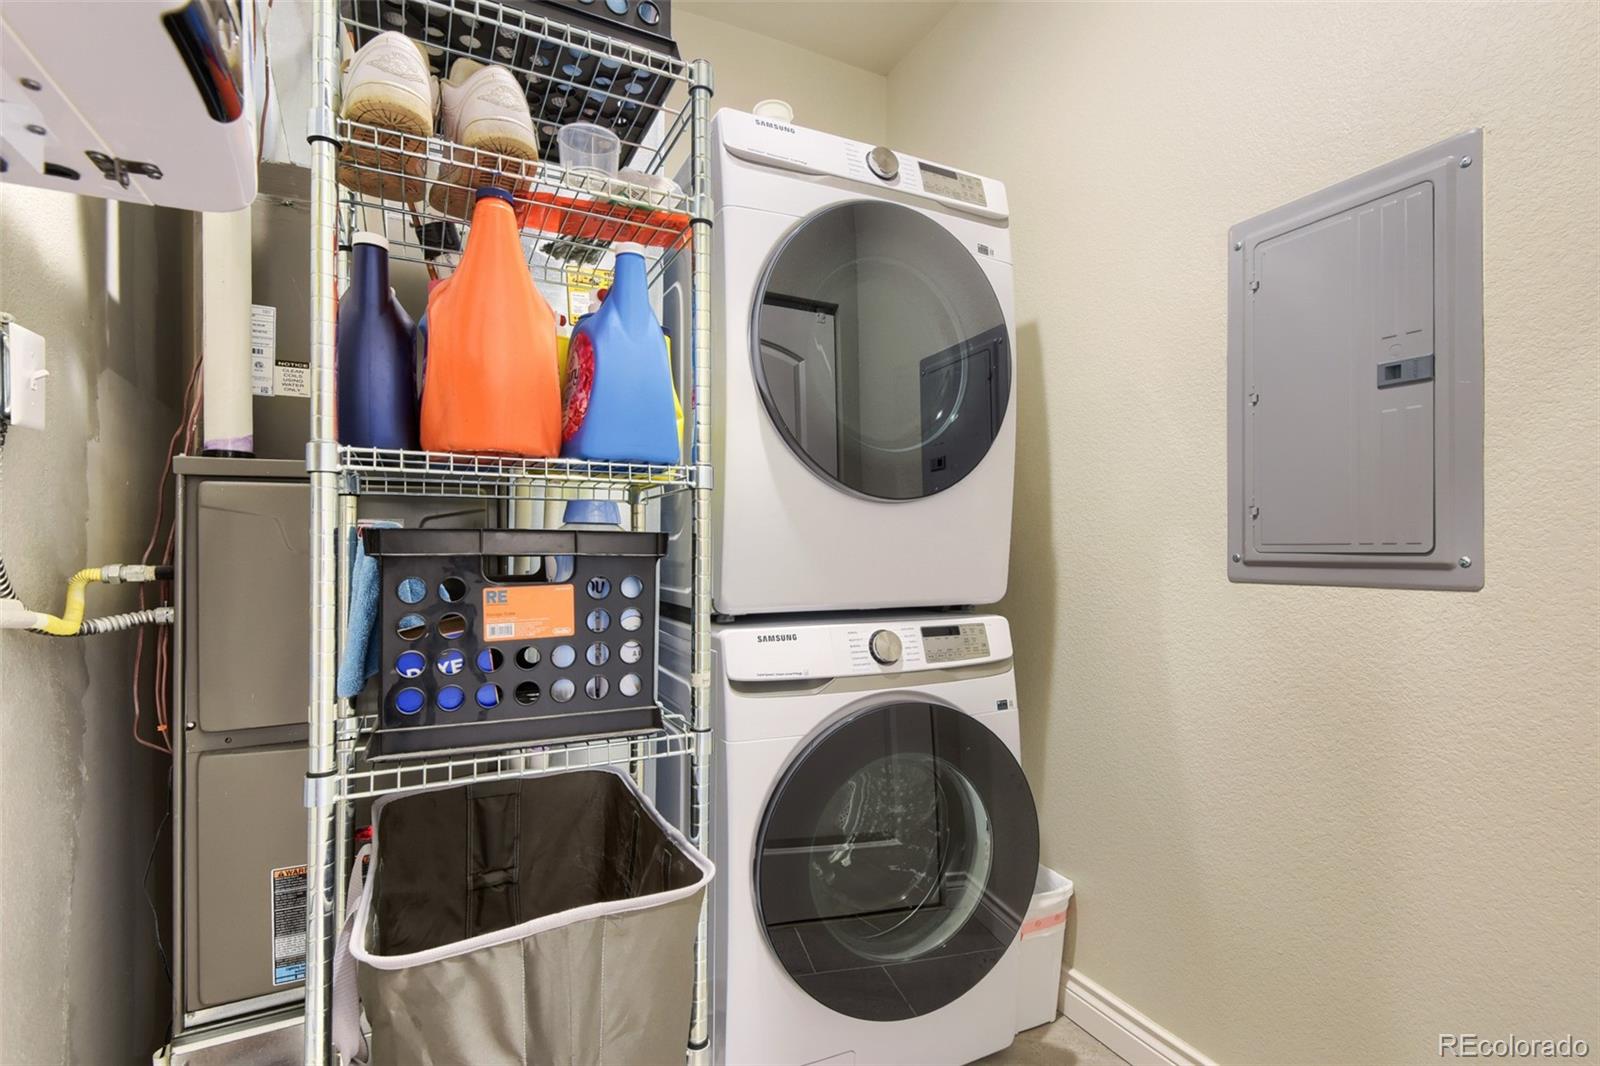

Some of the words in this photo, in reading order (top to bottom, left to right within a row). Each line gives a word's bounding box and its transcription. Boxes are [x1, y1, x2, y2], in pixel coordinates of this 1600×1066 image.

[755, 119, 796, 134] SAMSUNG
[486, 590, 508, 604] RE
[757, 633, 798, 643] SAMSUNG
